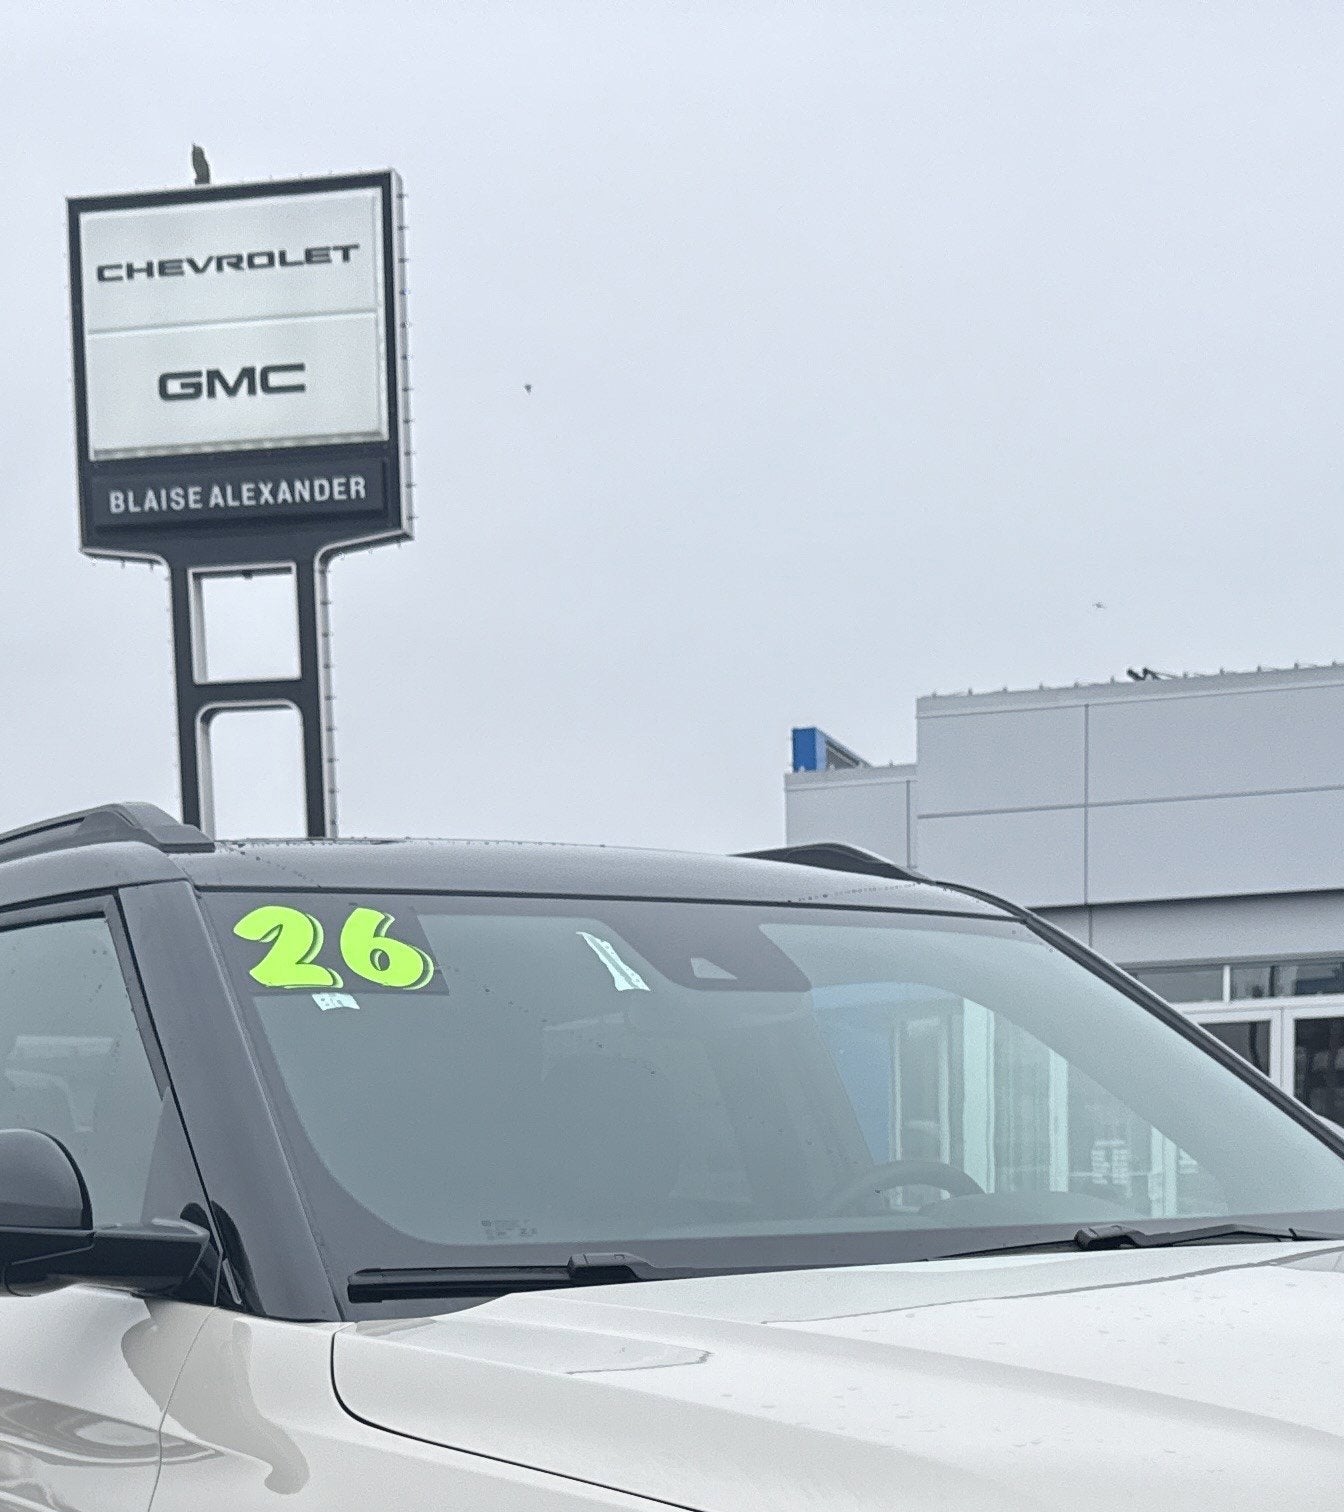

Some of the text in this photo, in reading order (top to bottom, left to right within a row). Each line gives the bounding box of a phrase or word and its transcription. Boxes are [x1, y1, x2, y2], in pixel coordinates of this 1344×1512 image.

[96, 243, 361, 282] CHEVROLET
[157, 361, 307, 402] GMC
[108, 475, 367, 515] BLAISE ALEXANDER
[232, 904, 435, 991] 26
